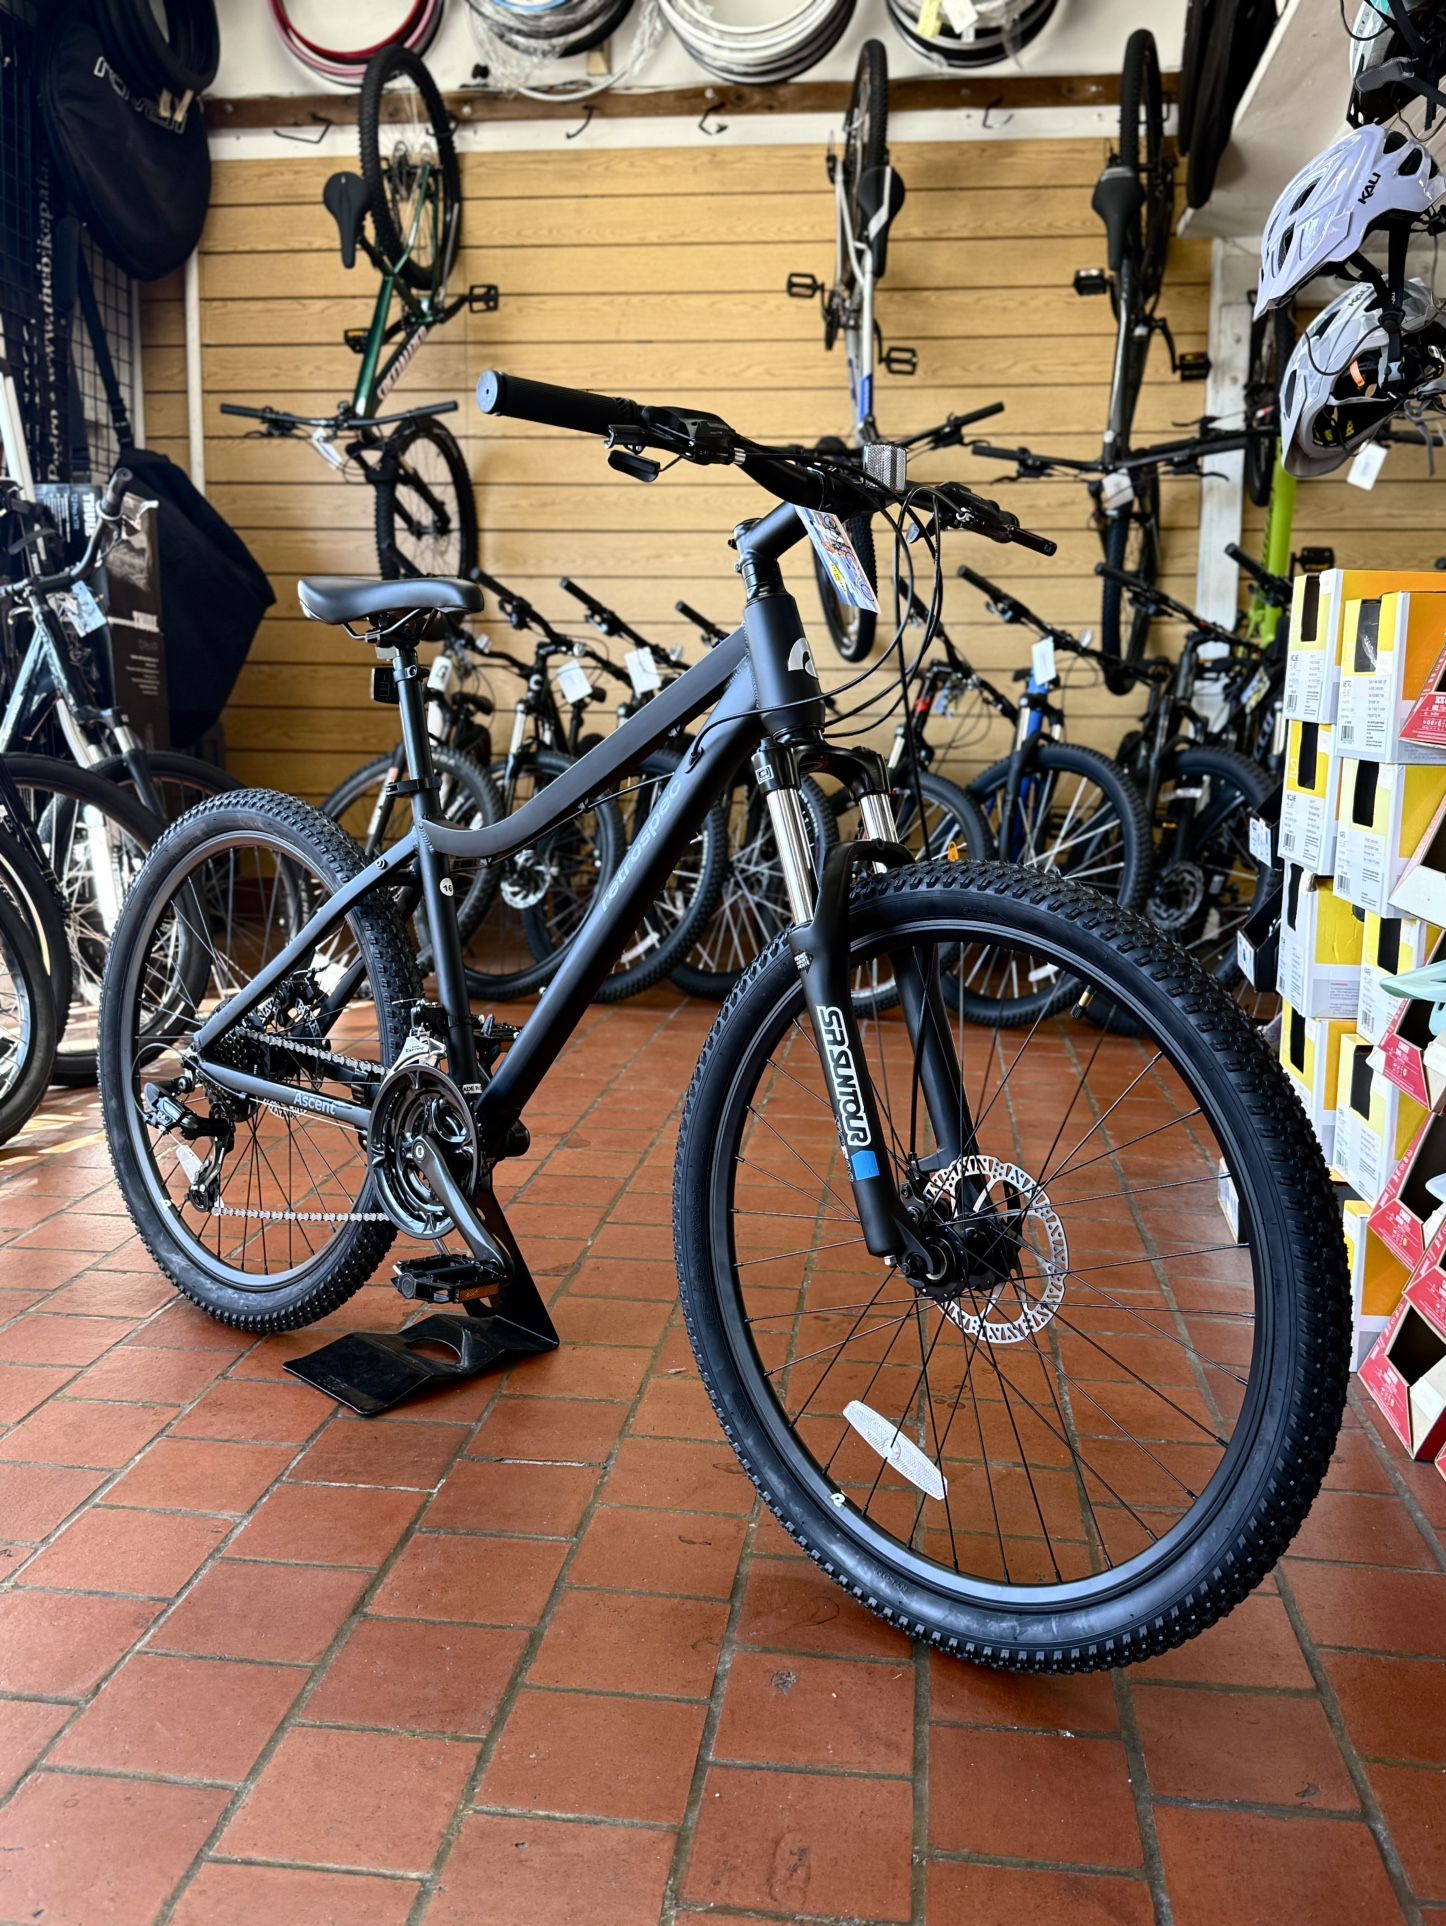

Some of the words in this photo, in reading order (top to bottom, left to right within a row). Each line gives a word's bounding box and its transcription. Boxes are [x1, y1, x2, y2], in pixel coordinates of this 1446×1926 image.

[1357, 172, 1381, 205] KALI
[601, 780, 682, 913] retrospec
[818, 1007, 847, 1047] SR
[293, 1091, 336, 1116] Ascent
[830, 1049, 869, 1146] SUNTOUR
